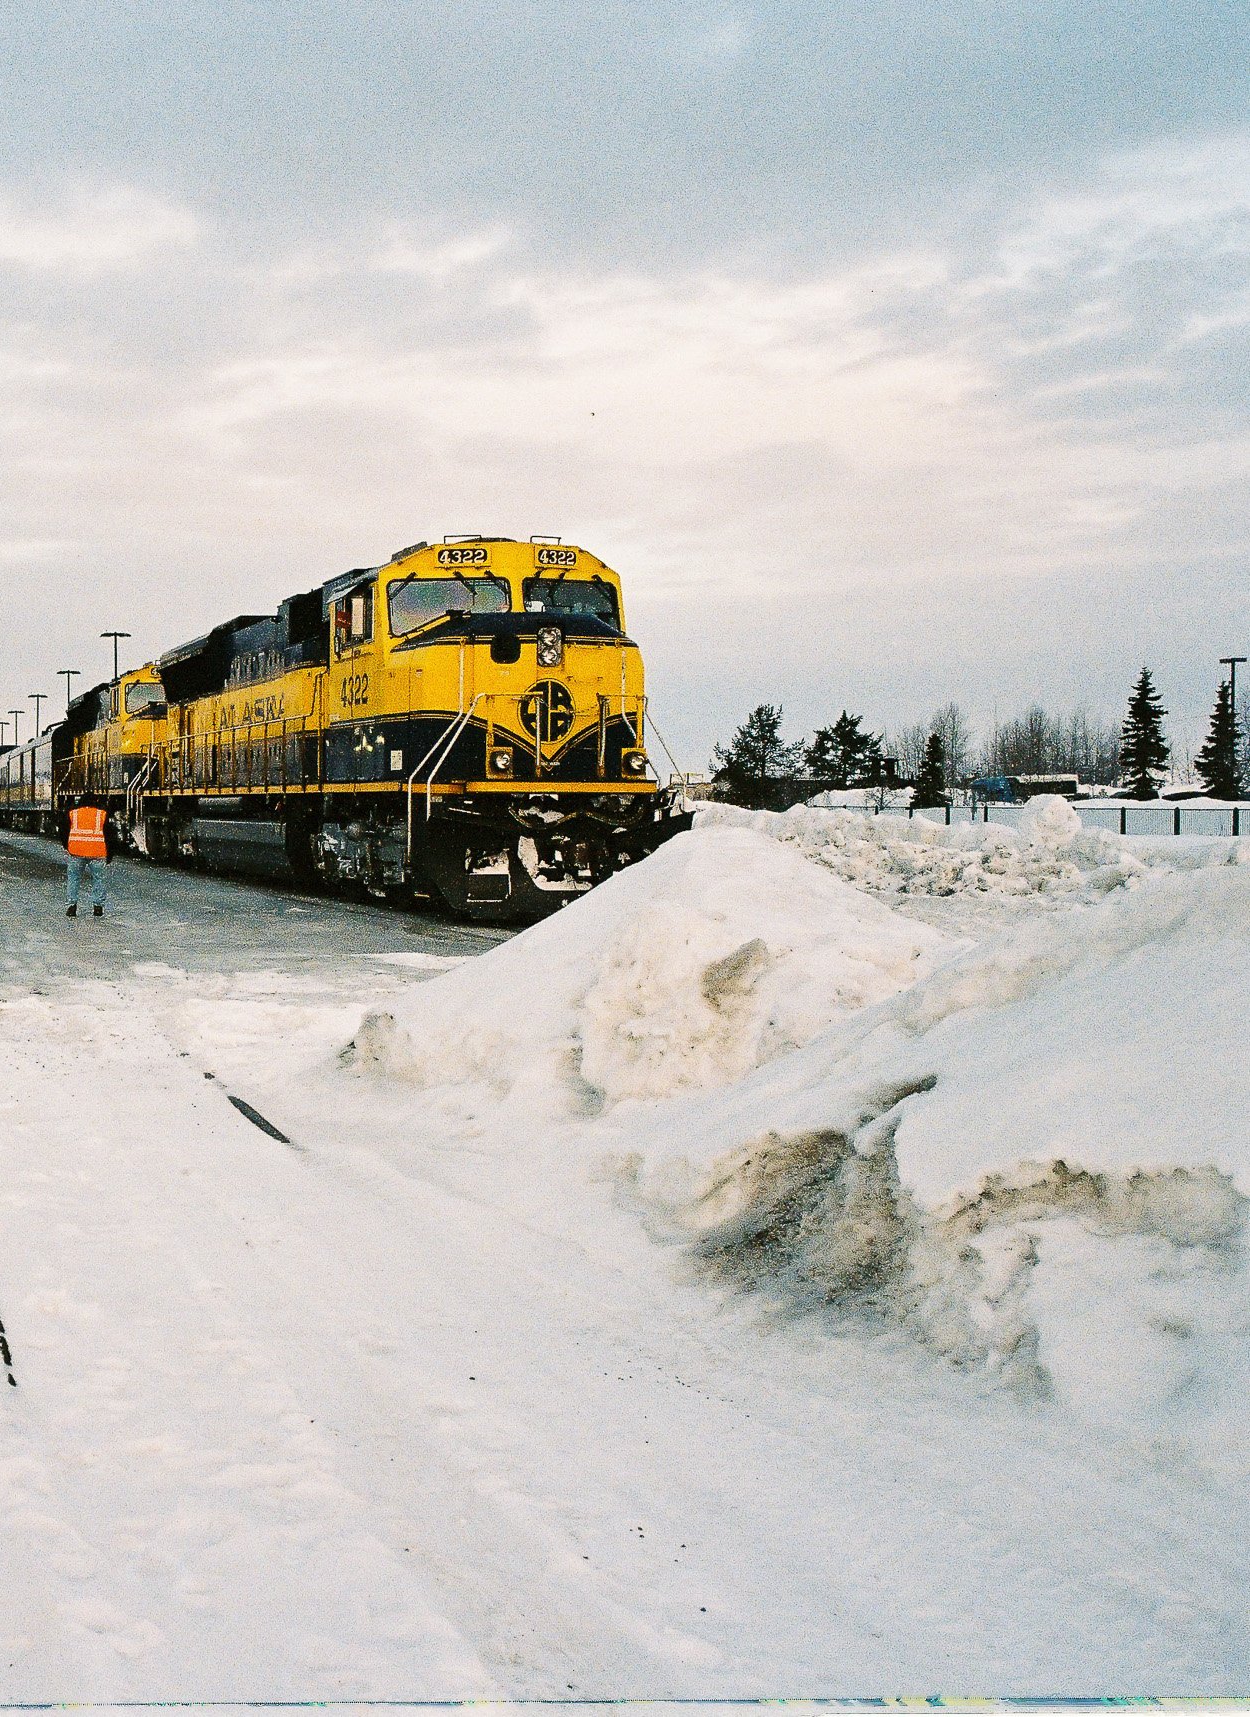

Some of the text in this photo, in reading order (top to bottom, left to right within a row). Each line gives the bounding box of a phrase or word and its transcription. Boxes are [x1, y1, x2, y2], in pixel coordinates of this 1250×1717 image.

[439, 549, 485, 564] 4322
[539, 549, 575, 565] 4322
[340, 672, 369, 707] 4322
